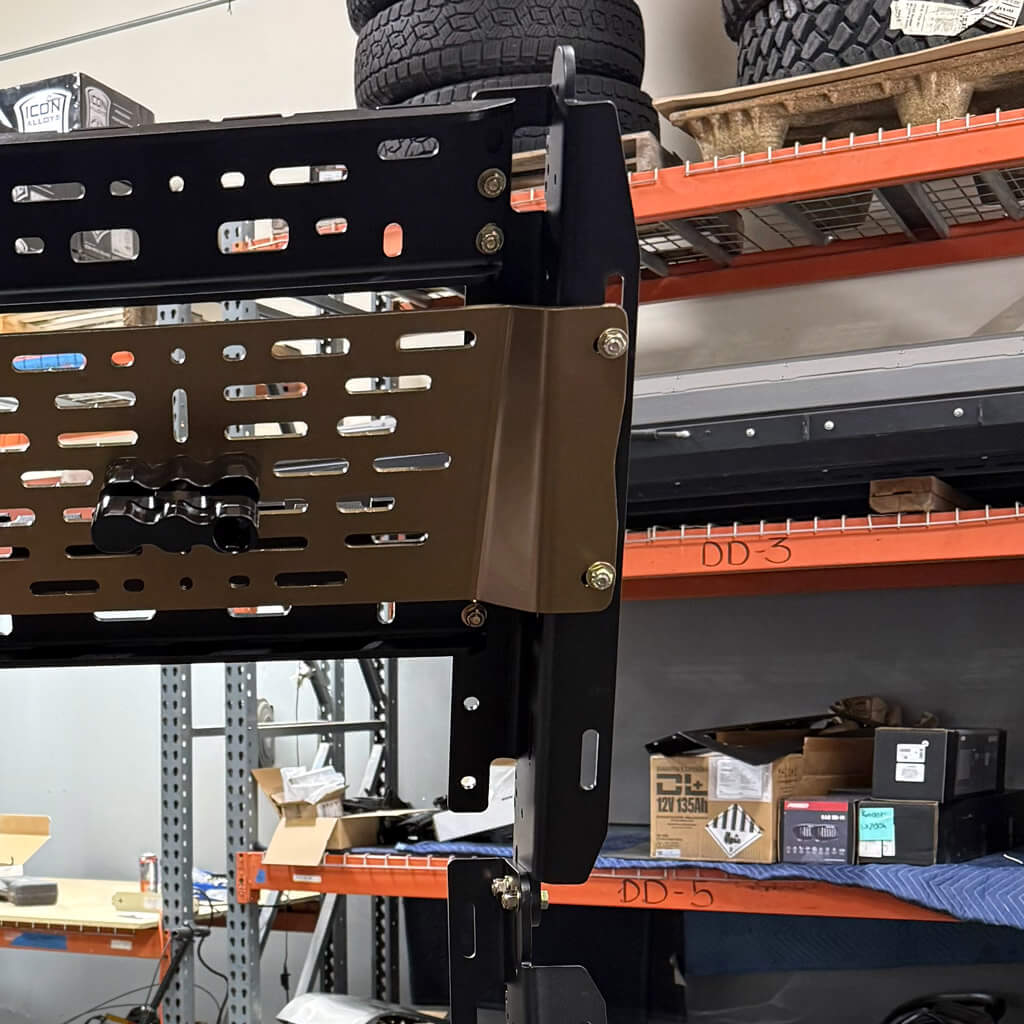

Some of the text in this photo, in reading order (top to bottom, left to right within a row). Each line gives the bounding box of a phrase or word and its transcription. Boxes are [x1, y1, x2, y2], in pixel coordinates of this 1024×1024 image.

[26, 98, 61, 119] ICON
[702, 537, 792, 567] DD-3
[658, 797, 708, 813] 12V 135Ah
[618, 879, 714, 908] DD-5
